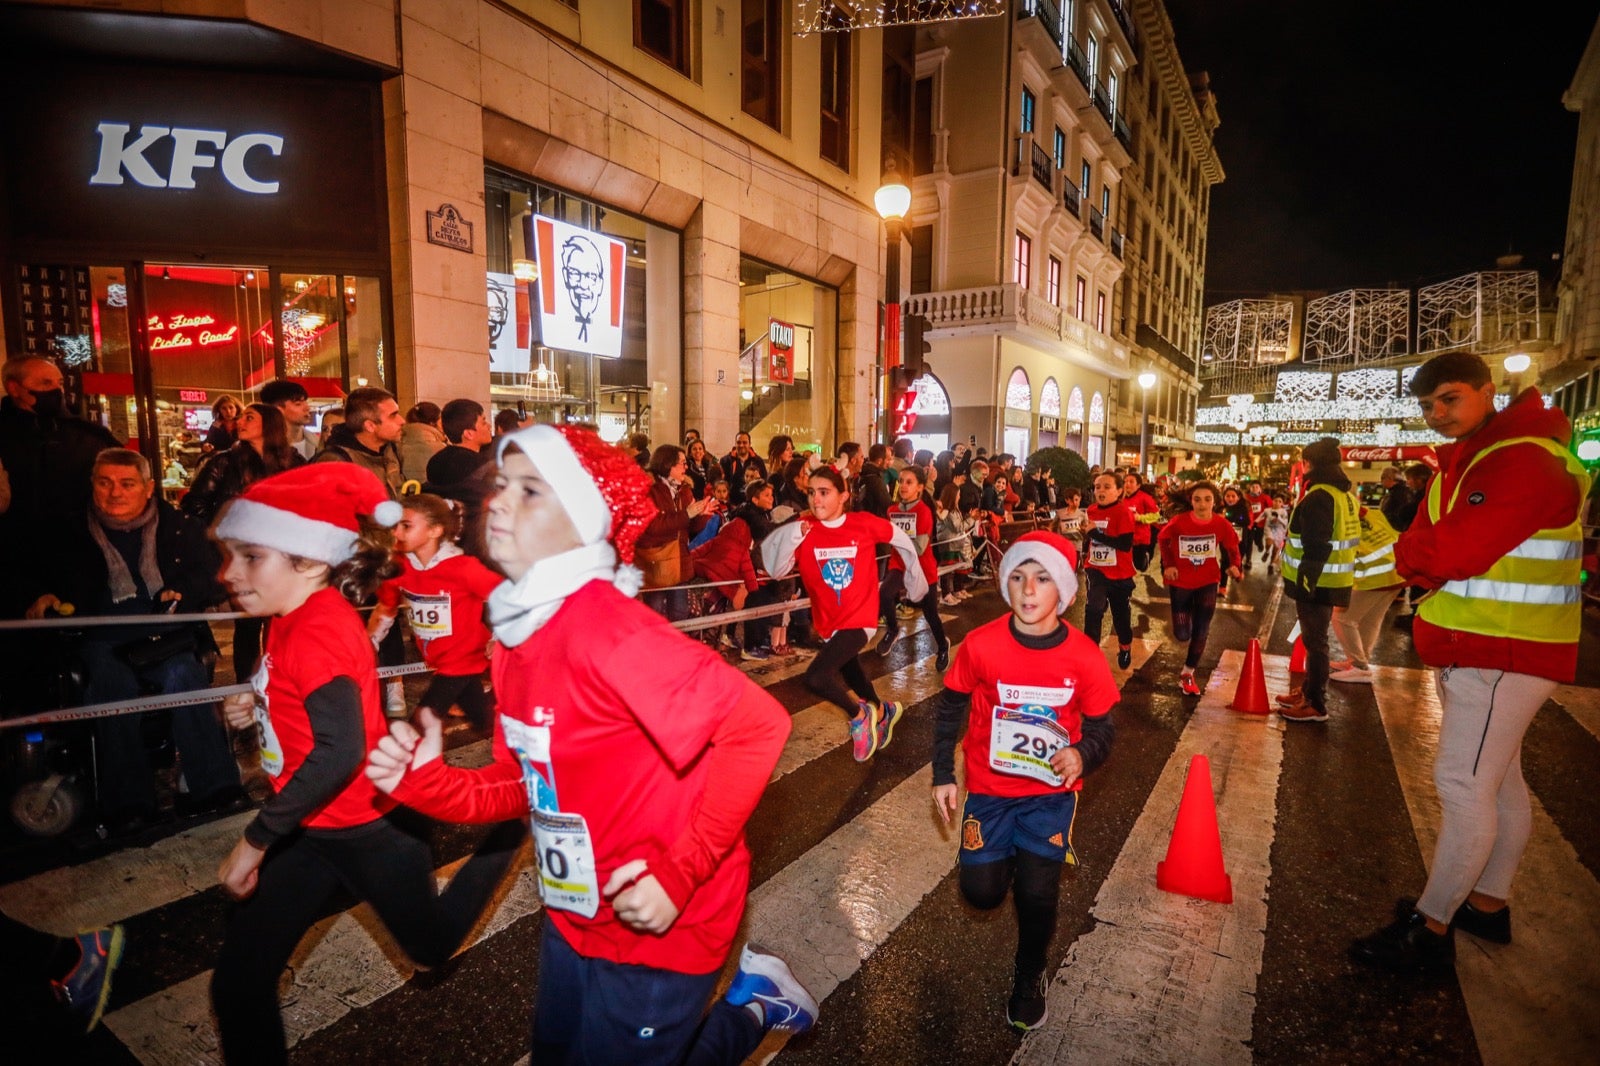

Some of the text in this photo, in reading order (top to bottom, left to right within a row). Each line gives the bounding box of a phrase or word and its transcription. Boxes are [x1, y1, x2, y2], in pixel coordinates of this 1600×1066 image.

[90, 122, 284, 193] KFC
[770, 321, 793, 347] OTAKU
[1187, 544, 1210, 553] 268
[1005, 688, 1020, 699] 30
